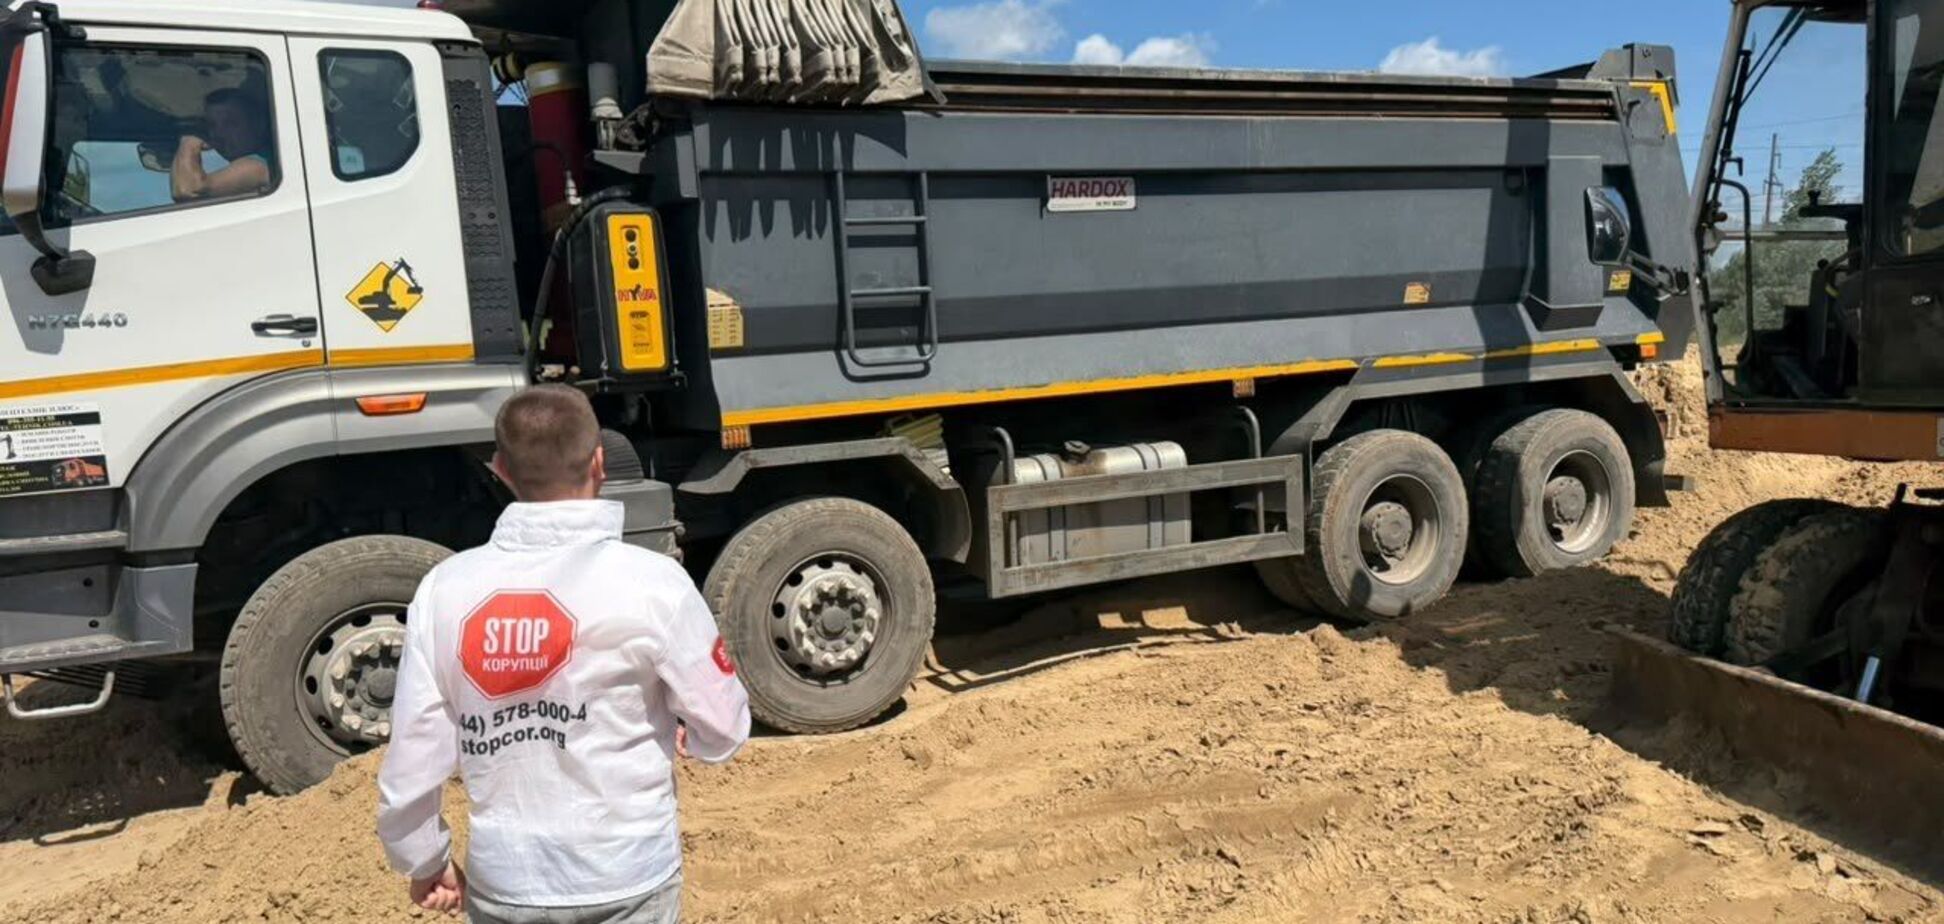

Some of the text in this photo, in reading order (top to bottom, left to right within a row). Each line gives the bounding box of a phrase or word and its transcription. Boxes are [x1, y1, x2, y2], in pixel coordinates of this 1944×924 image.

[1052, 181, 1128, 198] HARDOX
[483, 616, 549, 654] STOP
[482, 655, 549, 672] КОРУПЦІЇ
[461, 727, 566, 756] stopcor.org
